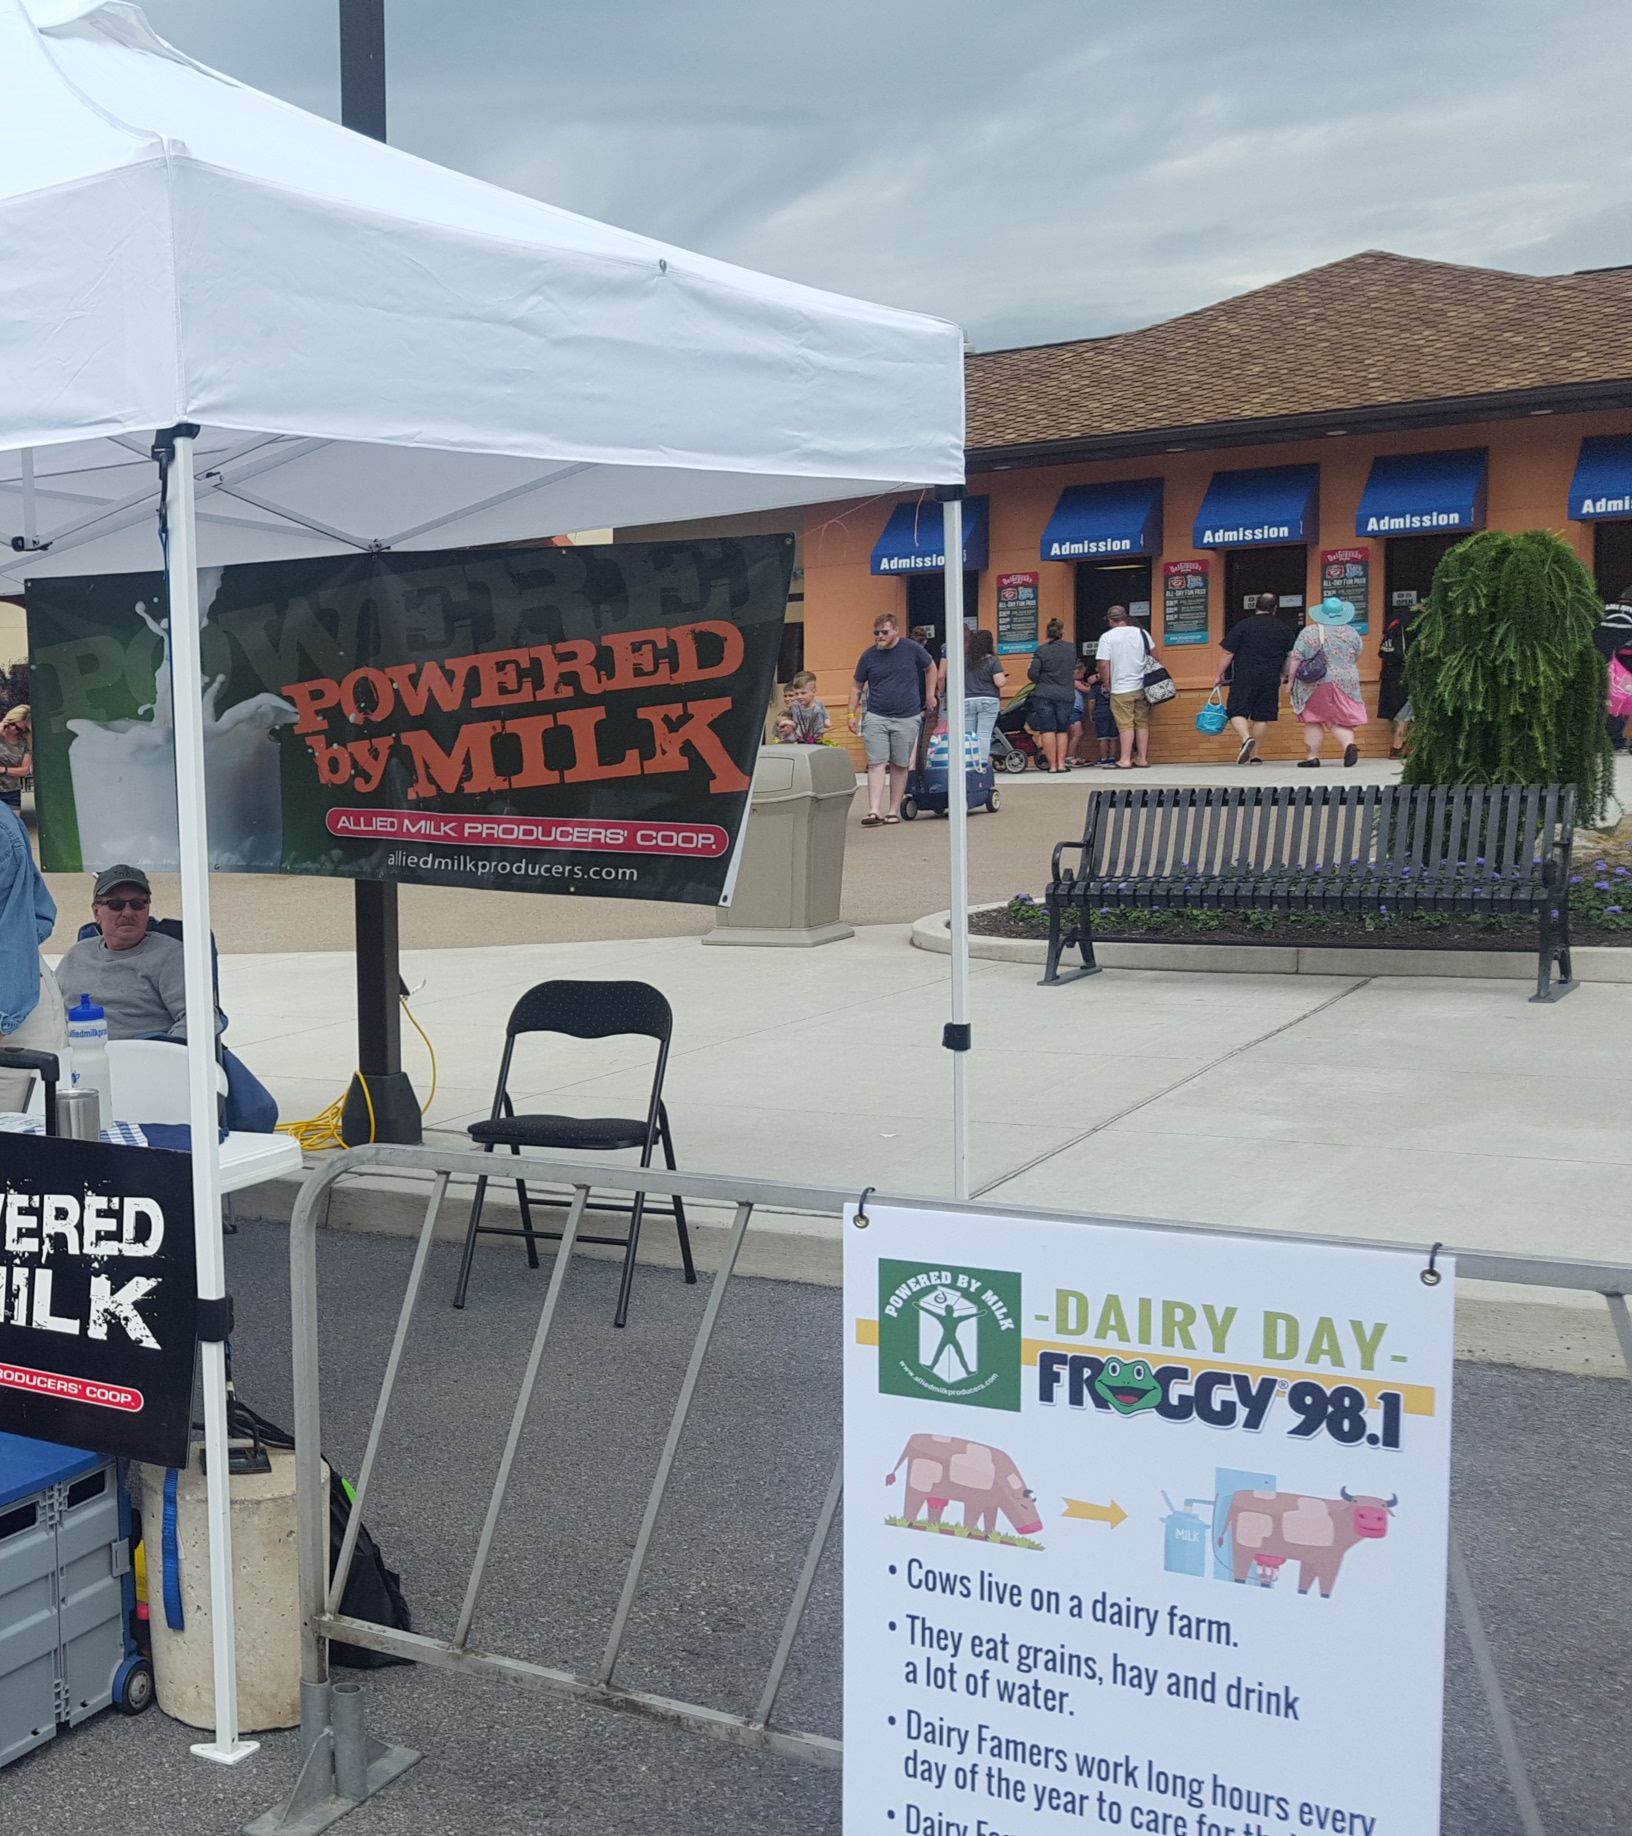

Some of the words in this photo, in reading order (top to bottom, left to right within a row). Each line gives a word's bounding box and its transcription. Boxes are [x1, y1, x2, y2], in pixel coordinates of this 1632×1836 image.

[1367, 511, 1460, 532] Admission
[1581, 495, 1632, 514] Admi
[1050, 538, 1131, 556] Admission
[1203, 525, 1289, 544] Admission
[880, 553, 945, 570] Admissio
[281, 620, 745, 734] POWERED
[305, 733, 395, 793] by
[400, 697, 750, 800] MILK
[337, 815, 397, 832] ALLIED
[402, 818, 458, 837] MILK
[464, 821, 628, 845] PRODUCERS'
[636, 829, 716, 849] COOP.
[387, 850, 638, 882] alliedmilkproducers.com
[884, 1270, 952, 1317] POWERED
[956, 1274, 981, 1293] BY
[981, 1289, 1015, 1331] MILK
[85, 1385, 136, 1406] COOP.
[899, 1359, 999, 1396] www.alliedmilkproducers.com
[1286, 1379, 1402, 1450] 98.1
[1175, 1527, 1200, 1543] MILK
[907, 1557, 972, 1599] Cows
[980, 1570, 1023, 1608] live
[1030, 1587, 1060, 1615] on
[1069, 1593, 1083, 1619] a
[1092, 1591, 1159, 1637] dairy
[1167, 1604, 1239, 1648] farm.
[906, 1614, 963, 1658] They
[971, 1632, 1010, 1664] eat
[1016, 1643, 1104, 1685] grains,
[1112, 1652, 1158, 1697] hay
[1166, 1671, 1217, 1704] and
[1226, 1676, 1301, 1721] drink
[905, 1660, 918, 1684] a
[926, 1656, 958, 1692] lot
[965, 1669, 990, 1698] of
[996, 1678, 1075, 1717] water.
[906, 1709, 969, 1755] Dairy
[977, 1724, 1069, 1772] Famers
[1075, 1752, 1139, 1789] work
[1147, 1760, 1205, 1809] long
[1212, 1773, 1290, 1822] hours
[1299, 1802, 1377, 1836] every
[904, 1749, 947, 1789] day
[955, 1763, 979, 1792] of
[986, 1766, 1026, 1803] the
[1033, 1783, 1089, 1817] year
[1096, 1790, 1122, 1824] to
[1131, 1804, 1187, 1836] care
